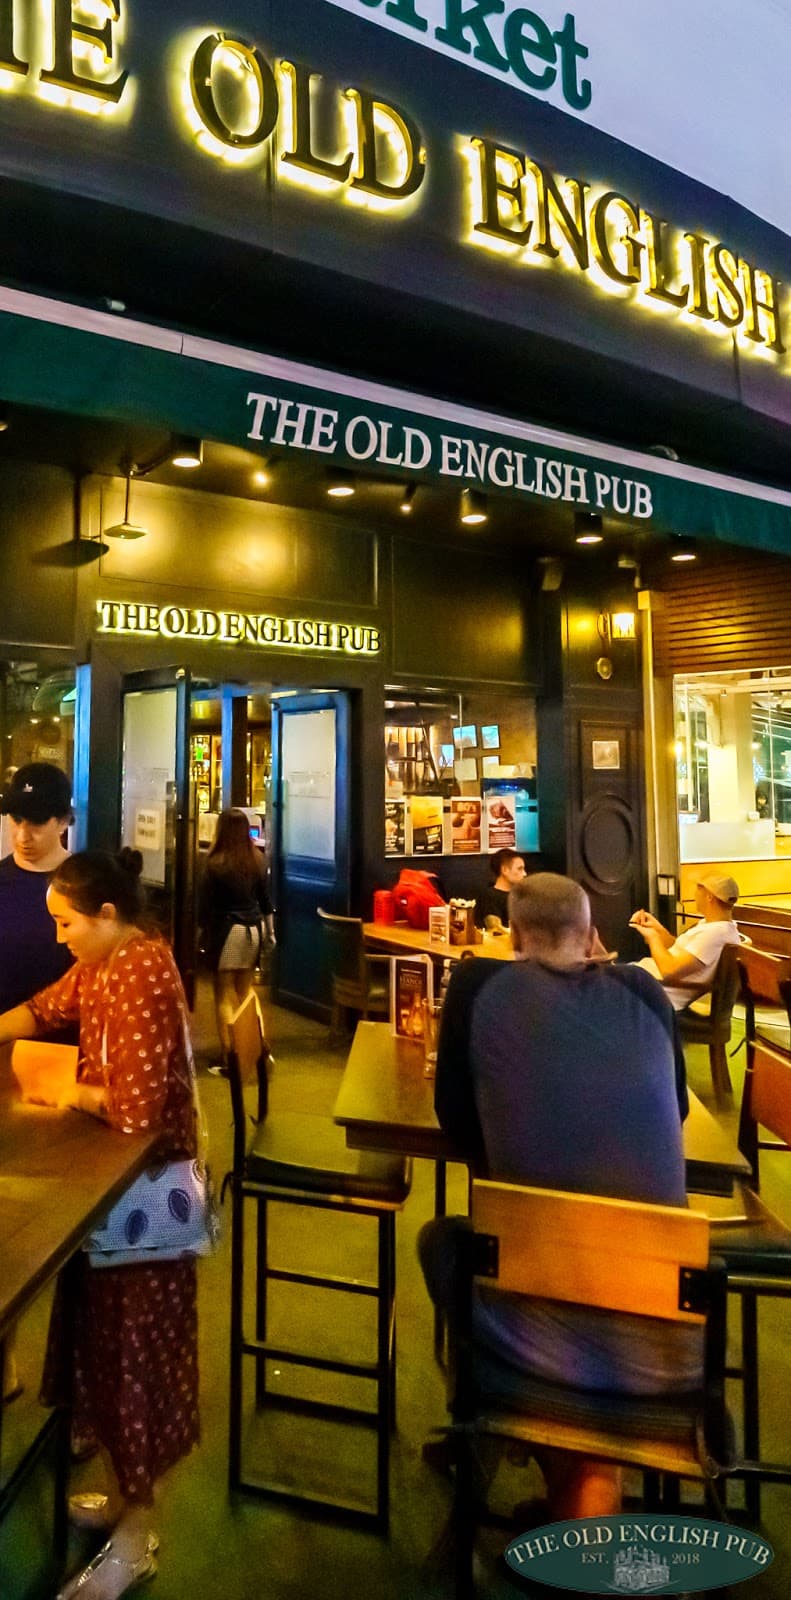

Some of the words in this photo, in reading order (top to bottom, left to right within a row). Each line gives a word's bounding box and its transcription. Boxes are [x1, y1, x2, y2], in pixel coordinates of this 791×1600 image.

[190, 32, 427, 201] OLD
[470, 137, 788, 355] ENGLISH
[247, 392, 338, 454] THE
[345, 415, 432, 470] OLD
[439, 435, 589, 504] ENGLISH
[594, 472, 654, 519] PUB
[101, 602, 160, 632] THE
[164, 608, 219, 636] OLD
[223, 613, 330, 648] ENGLISH
[336, 626, 380, 652] PUB
